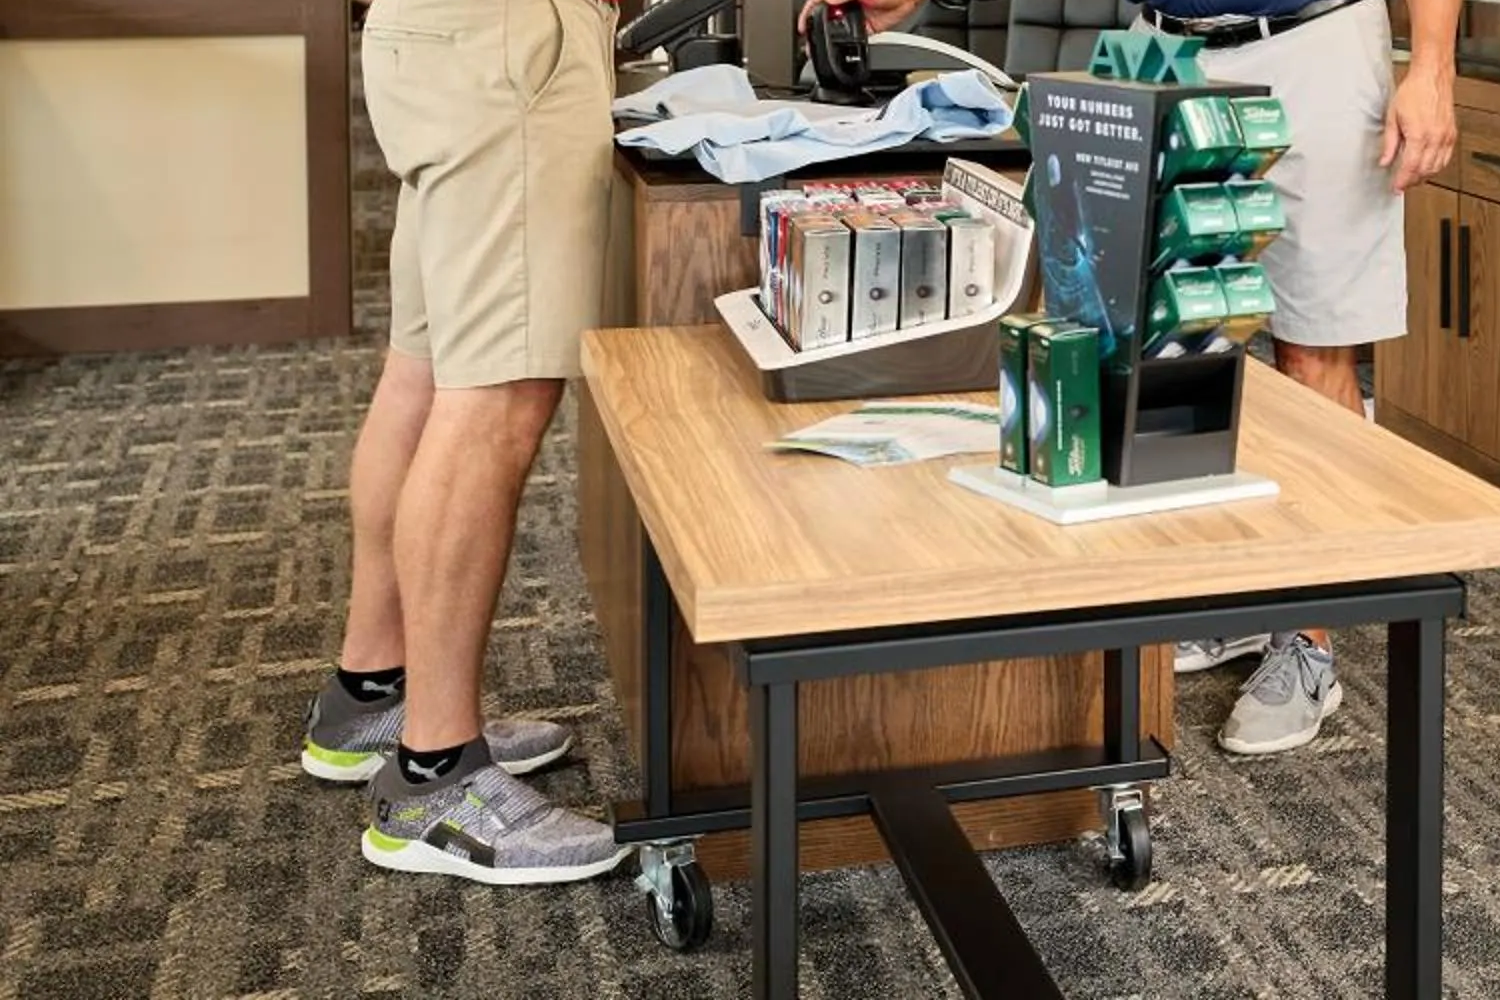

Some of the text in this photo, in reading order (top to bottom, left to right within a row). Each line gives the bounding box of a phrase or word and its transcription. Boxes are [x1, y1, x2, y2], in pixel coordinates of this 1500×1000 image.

[1088, 29, 1206, 85] AVX
[1047, 94, 1134, 119] YOUR NUMBERS
[1039, 113, 1065, 129] JUST
[1069, 117, 1091, 133] GOT
